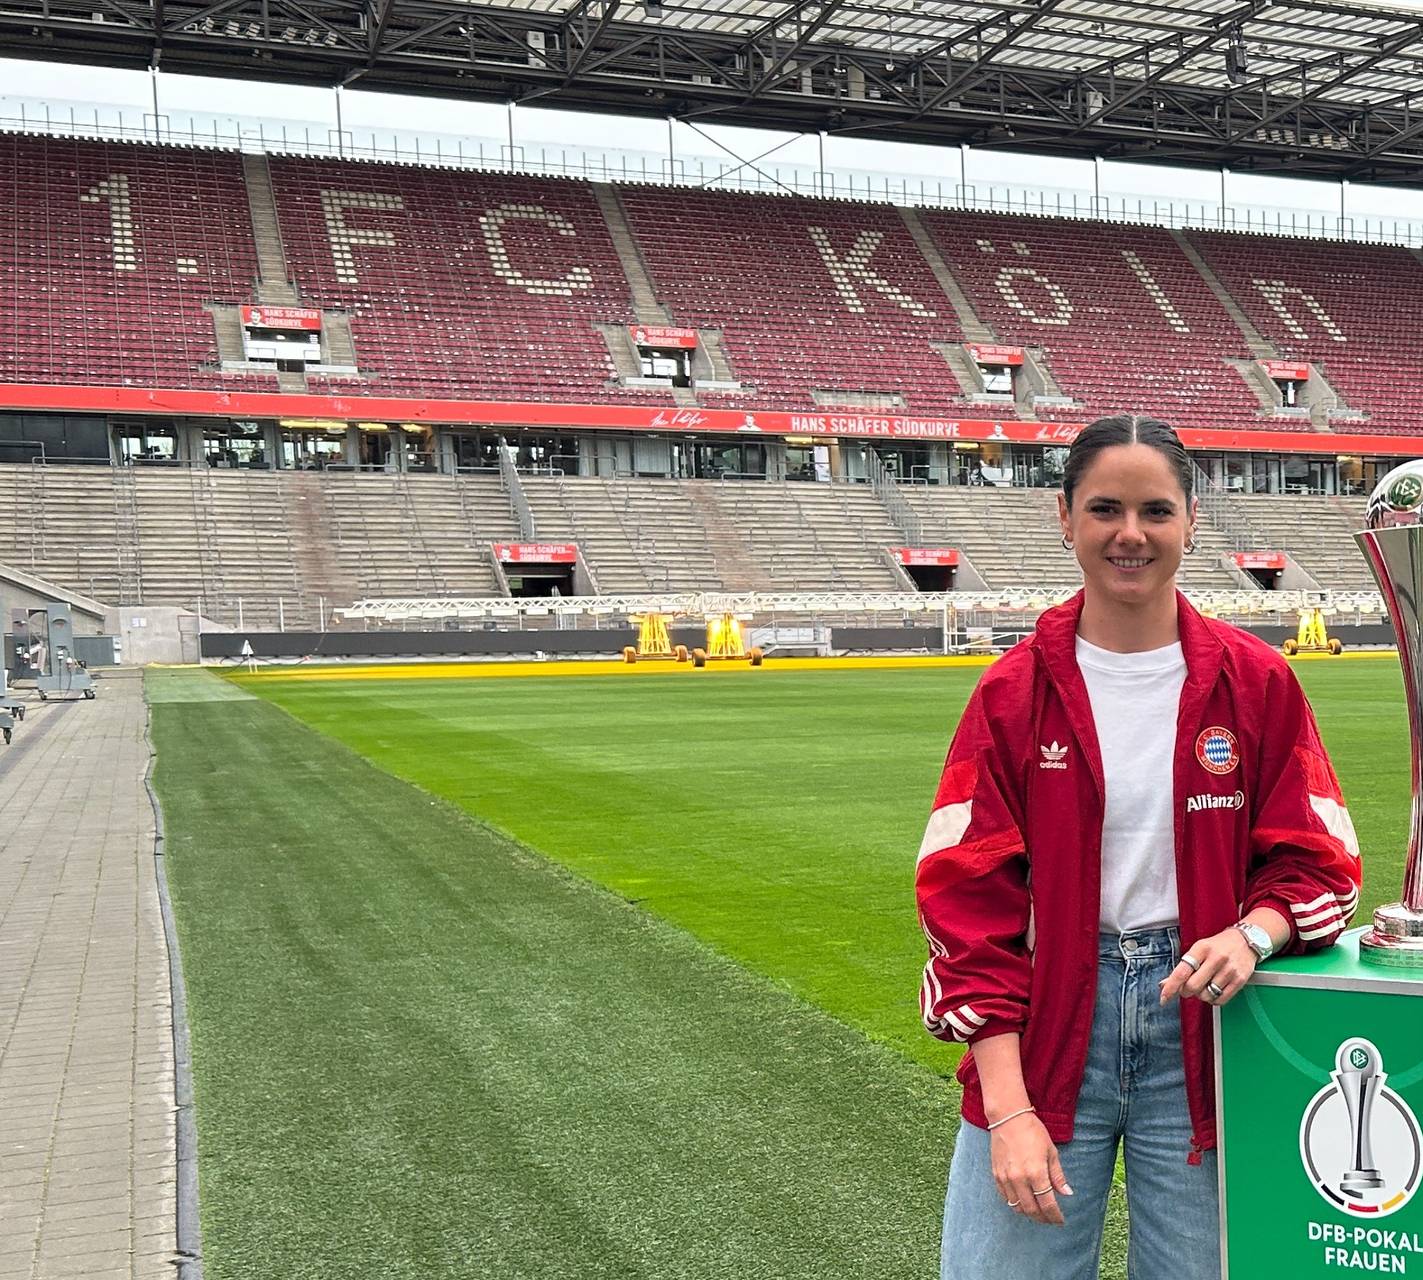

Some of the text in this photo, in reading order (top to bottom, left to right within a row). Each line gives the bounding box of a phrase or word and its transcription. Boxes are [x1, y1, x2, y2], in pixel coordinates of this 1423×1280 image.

[80, 174, 1348, 342] 1. FC Köln
[265, 318, 302, 327] SÜDKURVE
[285, 310, 318, 319] SCHÄFER
[792, 417, 960, 436] HANS SCHÄFER SÜDKURVE
[1040, 761, 1068, 769] adidas
[1186, 793, 1234, 811] Allianz
[1308, 1222, 1423, 1253] DFB-POKAL
[1325, 1247, 1406, 1274] FRAUEN
